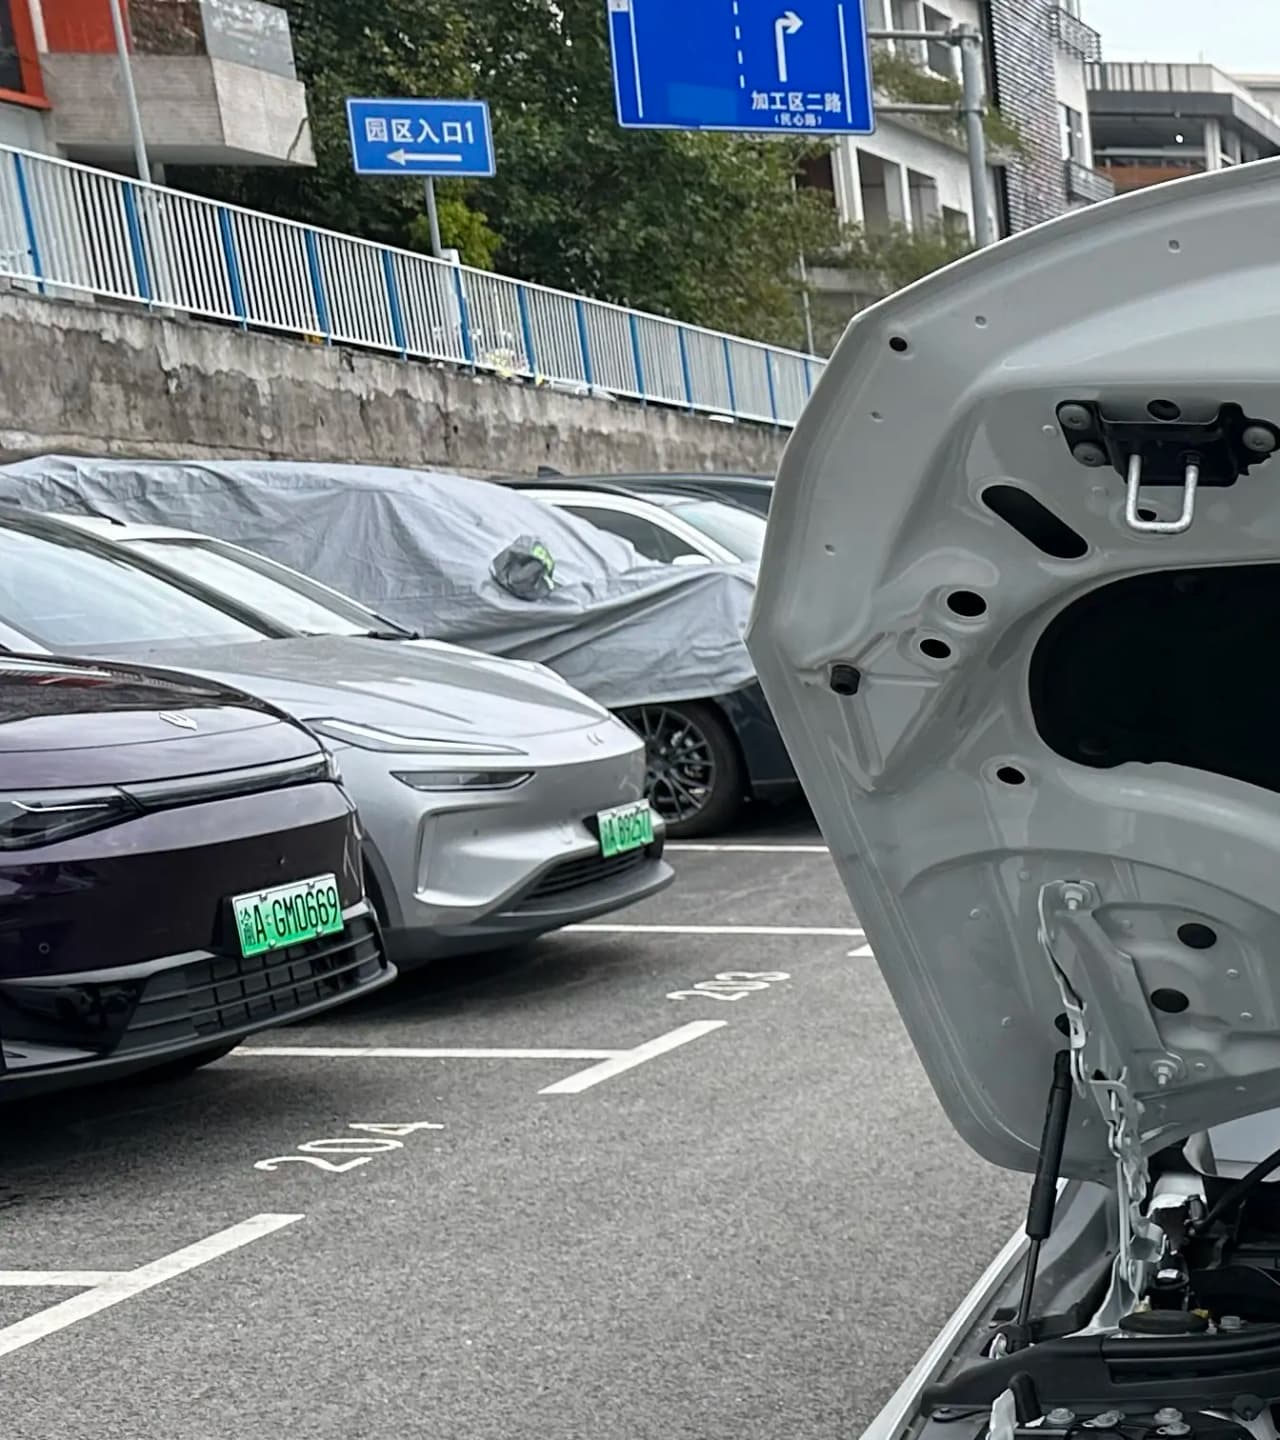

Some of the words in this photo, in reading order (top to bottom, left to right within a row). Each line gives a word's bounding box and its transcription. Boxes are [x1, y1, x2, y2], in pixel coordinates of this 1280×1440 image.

[751, 90, 841, 113] 加工区二路
[364, 117, 474, 144] 园区入口1
[666, 971, 791, 1001] 203
[253, 1121, 445, 1172] 204
